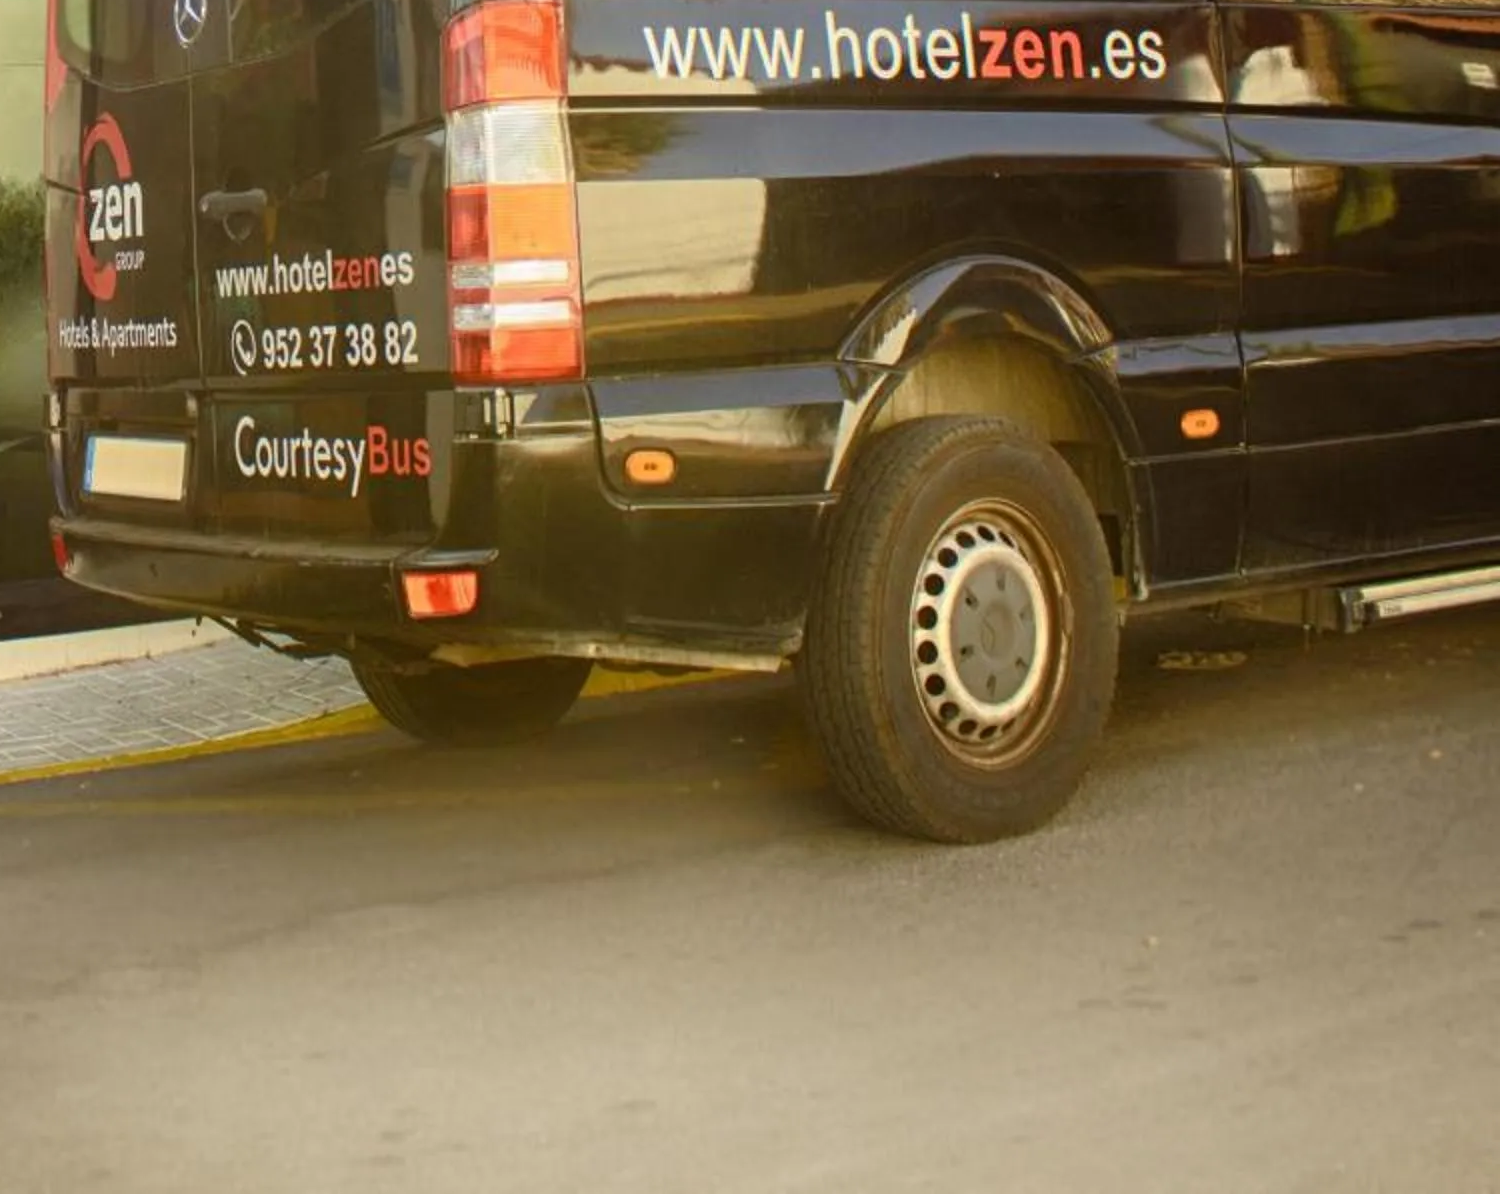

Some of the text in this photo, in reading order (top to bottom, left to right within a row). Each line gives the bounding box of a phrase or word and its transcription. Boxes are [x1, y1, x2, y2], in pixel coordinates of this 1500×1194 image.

[643, 10, 1167, 80] www.hotelzen.es
[89, 181, 144, 241] zen
[115, 249, 145, 271] GROUP
[59, 315, 90, 348] Hotels
[102, 316, 178, 358] Apartments
[261, 319, 419, 369] 952 37 38 82
